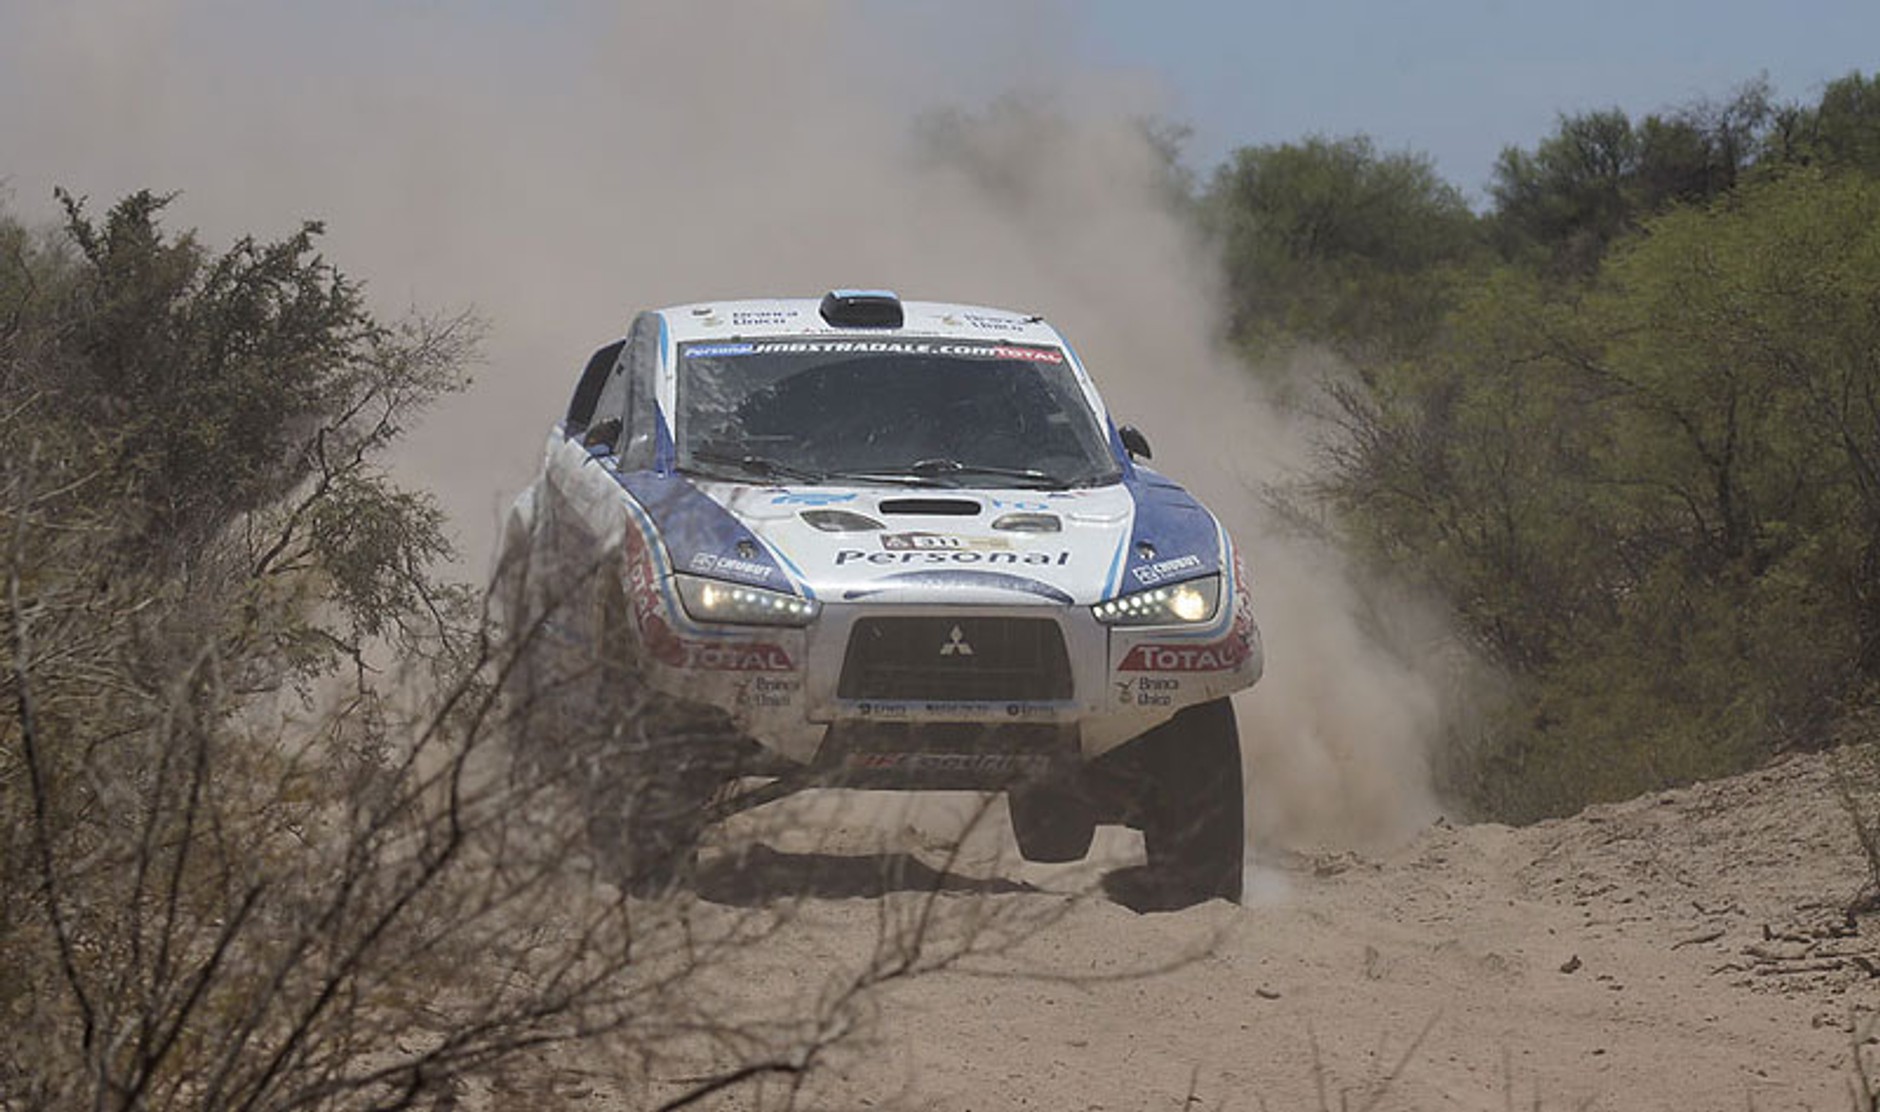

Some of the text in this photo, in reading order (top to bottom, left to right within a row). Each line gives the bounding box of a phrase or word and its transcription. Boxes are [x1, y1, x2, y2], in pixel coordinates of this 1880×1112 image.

[992, 346, 1063, 364] TOTAL
[834, 551, 1070, 566] Personal
[681, 643, 789, 669] TOTAL
[1136, 645, 1236, 670] TOTAL
